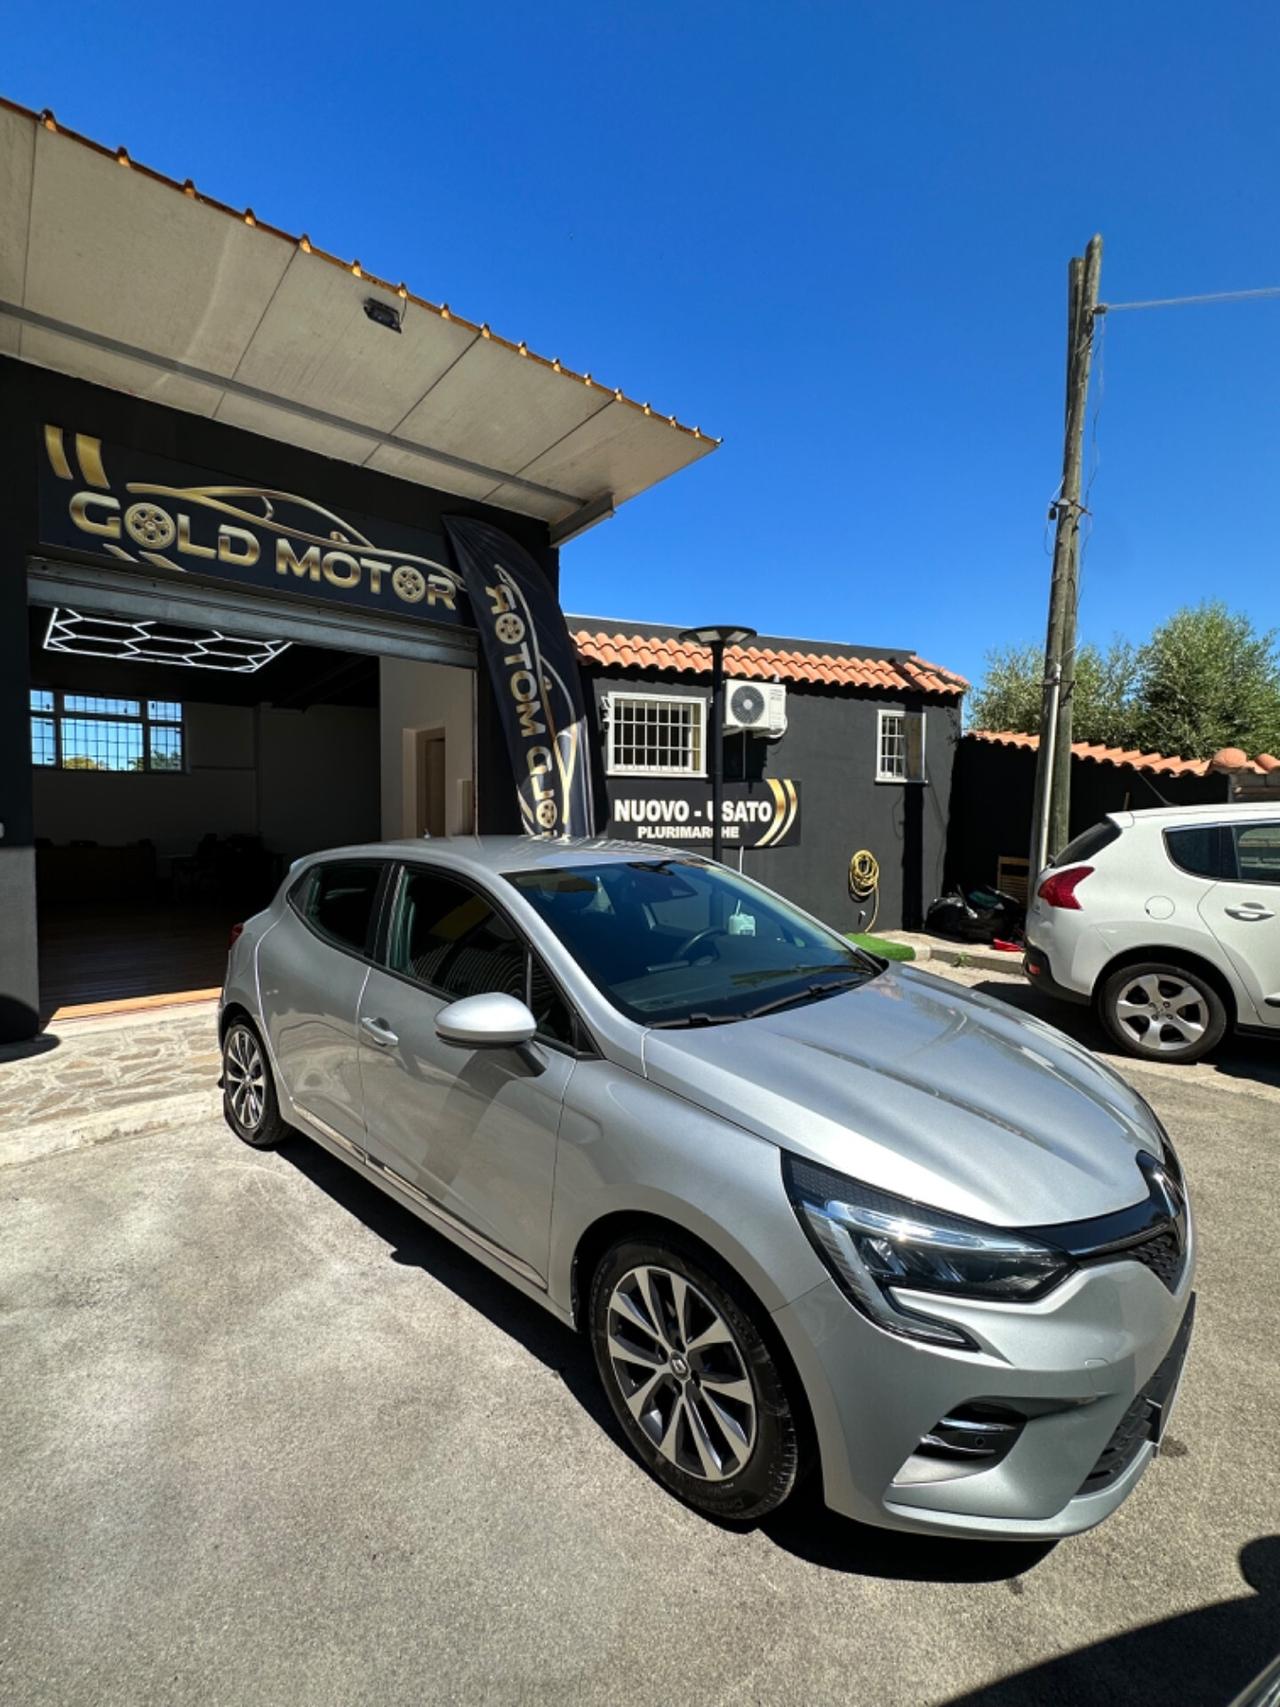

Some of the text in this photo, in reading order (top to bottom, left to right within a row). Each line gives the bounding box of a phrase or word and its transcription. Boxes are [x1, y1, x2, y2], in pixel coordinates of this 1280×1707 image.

[69, 491, 457, 610] GOLD MOTOR
[614, 799, 690, 822] NUOVO
[637, 826, 740, 839] PLURIMARHE
